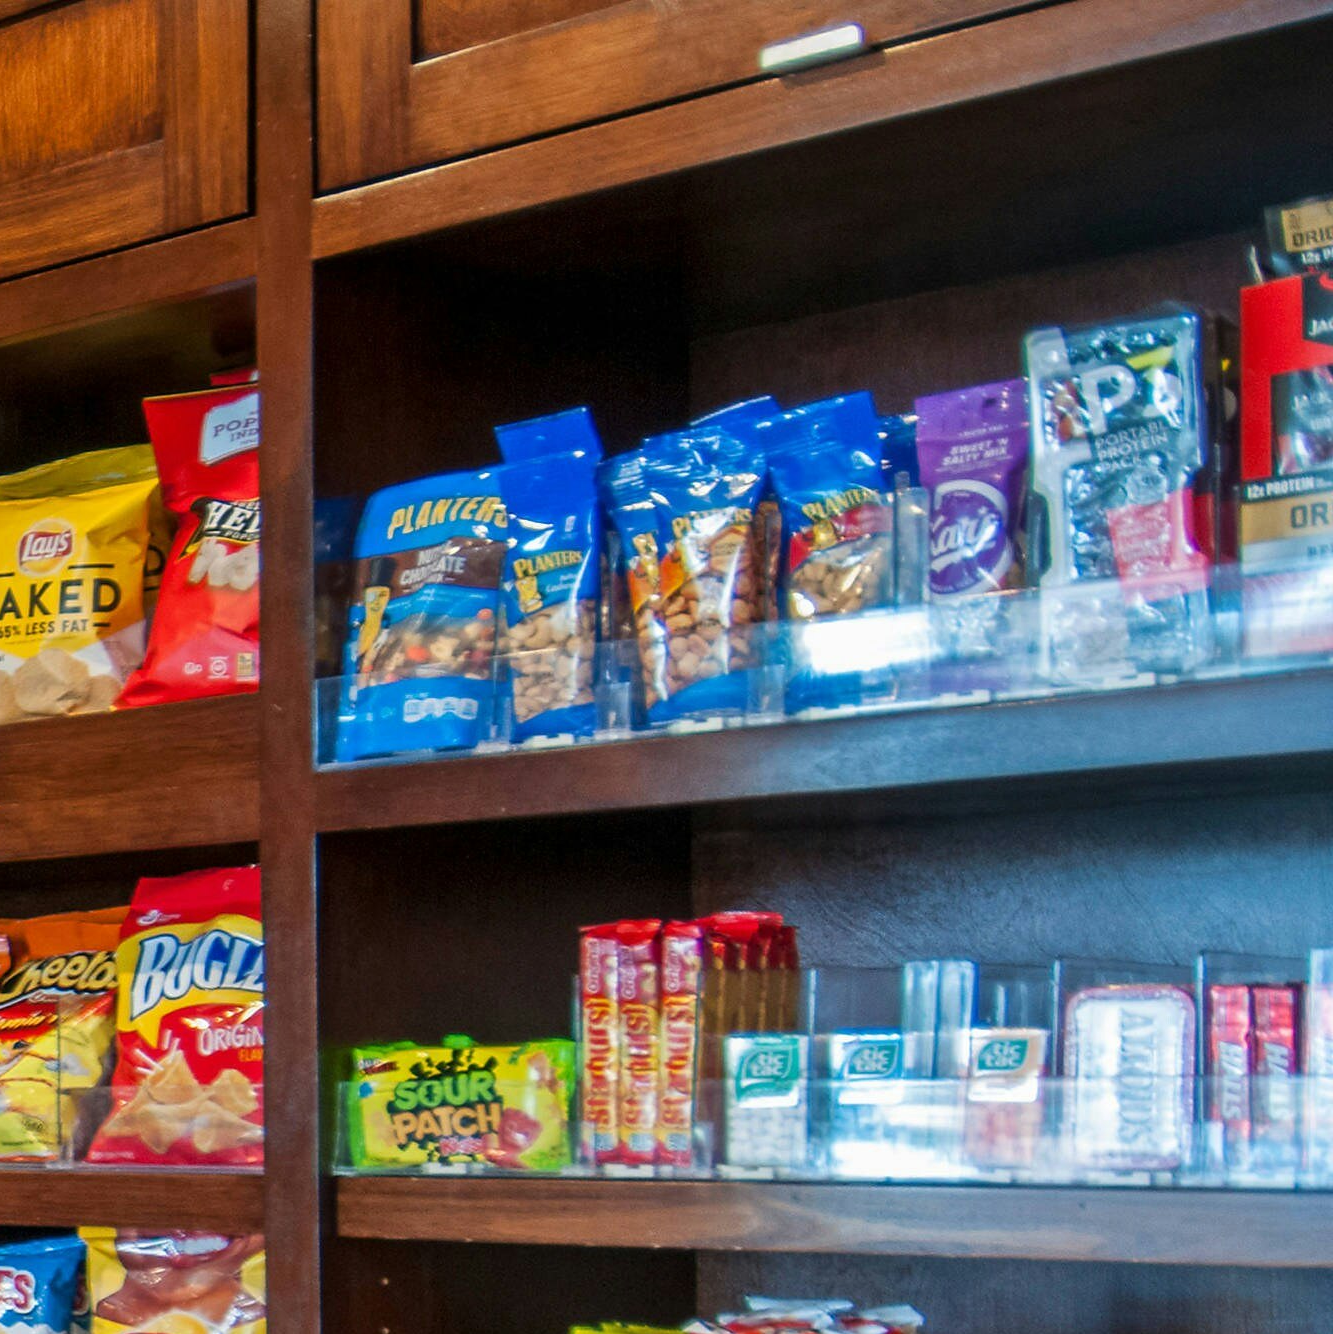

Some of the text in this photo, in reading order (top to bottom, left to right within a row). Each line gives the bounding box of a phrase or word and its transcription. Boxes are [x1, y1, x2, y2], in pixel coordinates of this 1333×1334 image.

[22, 529, 73, 562] Lay's
[513, 550, 584, 578] PLANTERS
[25, 621, 56, 636] LESS
[61, 618, 89, 633] FAT
[862, 1044, 890, 1062] tic
[993, 1039, 1022, 1057] tic
[757, 1048, 785, 1069] tic
[853, 1056, 889, 1074] tac
[984, 1051, 1021, 1068] tac
[751, 1063, 785, 1079] tac
[394, 1070, 495, 1111] SOUR
[392, 1102, 501, 1143] PATCH
